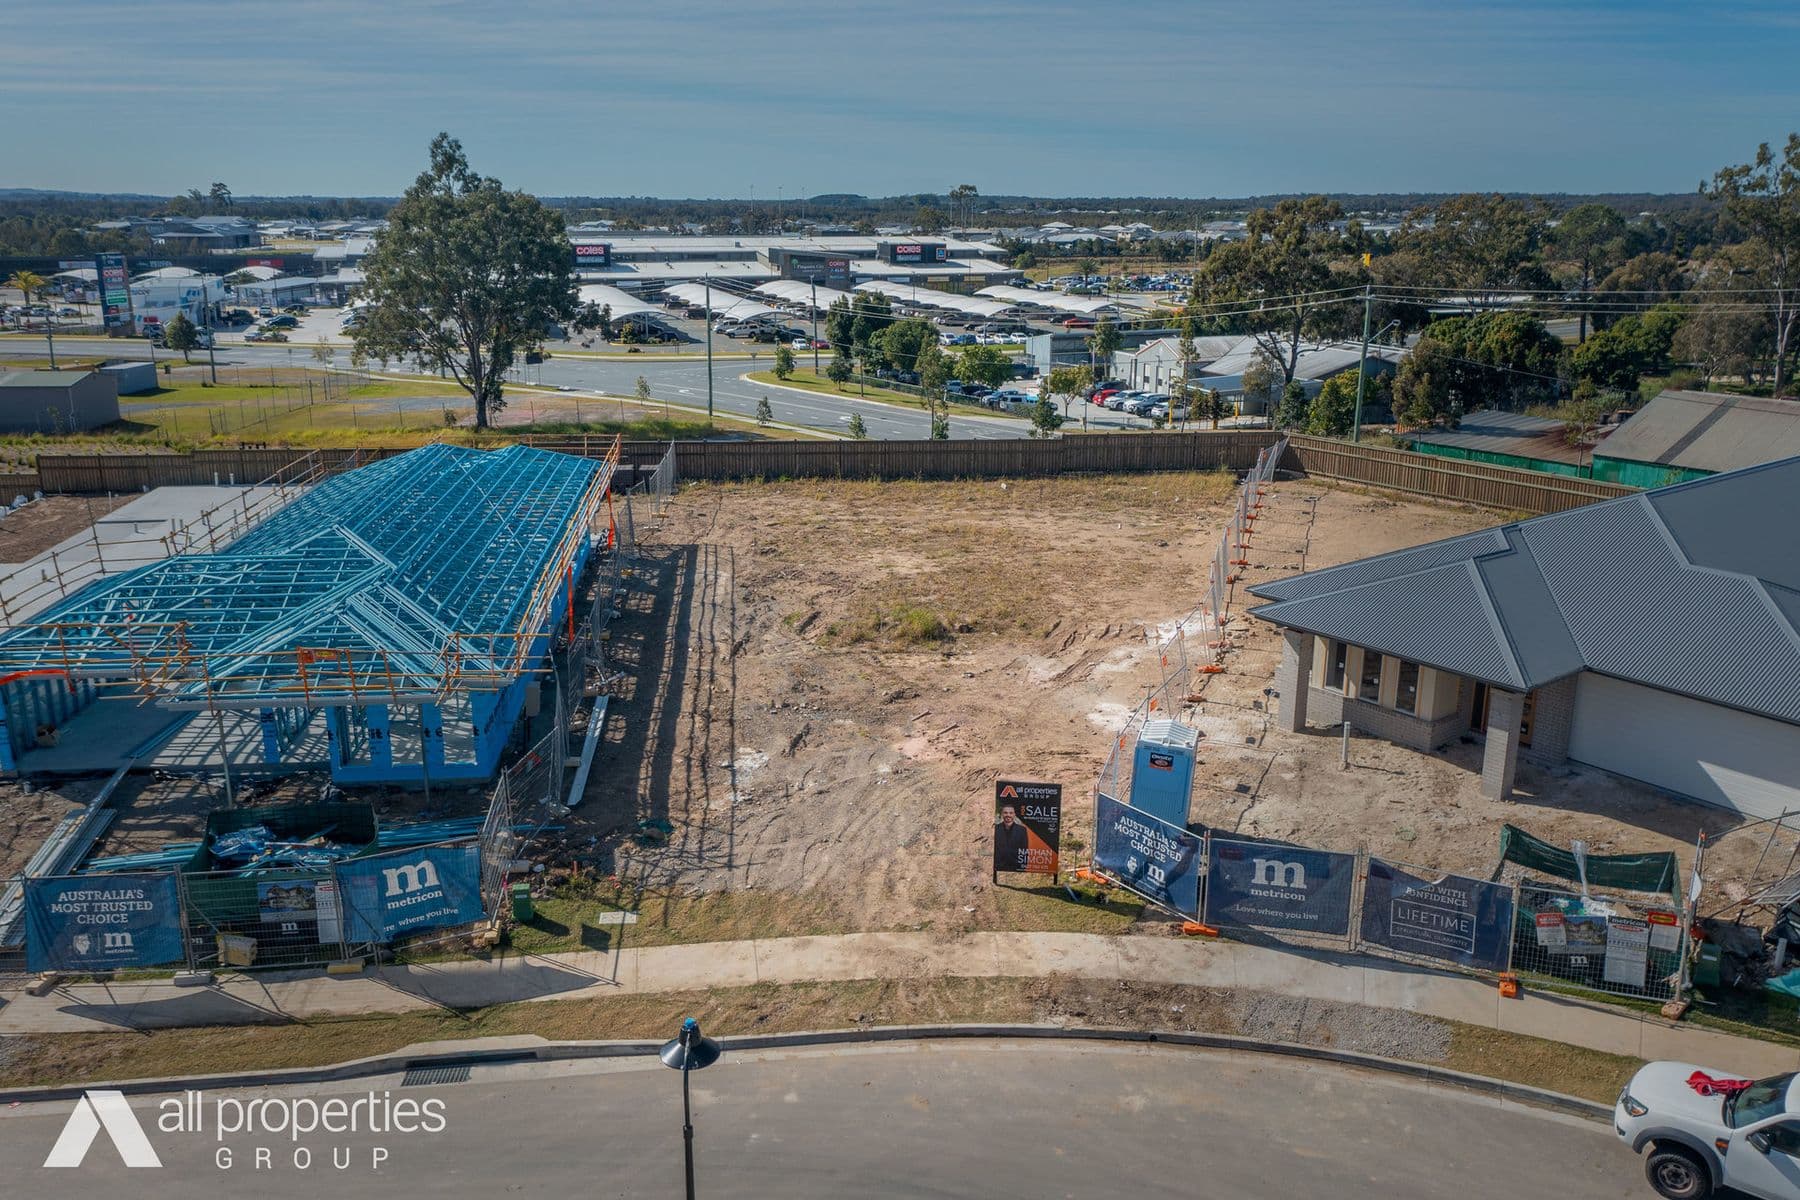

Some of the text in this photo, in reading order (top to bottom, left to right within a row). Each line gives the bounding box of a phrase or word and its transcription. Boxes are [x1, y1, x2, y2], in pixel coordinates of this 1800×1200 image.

[576, 246, 605, 255] coles
[896, 245, 921, 253] coles
[1024, 786, 1058, 796] properties
[1025, 805, 1058, 817] SALE
[1114, 822, 1182, 862] MOST TRUSTED
[1018, 847, 1053, 857] NATHAN
[1130, 840, 1167, 863] CHOICE
[1017, 855, 1053, 865] SIMON
[382, 860, 441, 897] m
[1251, 858, 1307, 889] m
[58, 889, 145, 902] AUSTRALIA'S
[387, 890, 444, 909] metricon
[1250, 888, 1306, 901] metricon
[1437, 887, 1467, 900] WITH
[51, 901, 153, 913] MOST TRUSTED
[1235, 904, 1318, 920] Love where you live
[77, 914, 129, 924] CHOICE
[398, 914, 425, 927] where
[425, 909, 442, 922] you
[443, 907, 459, 915] live
[1398, 906, 1469, 933] LIFETIME
[104, 932, 134, 948] m
